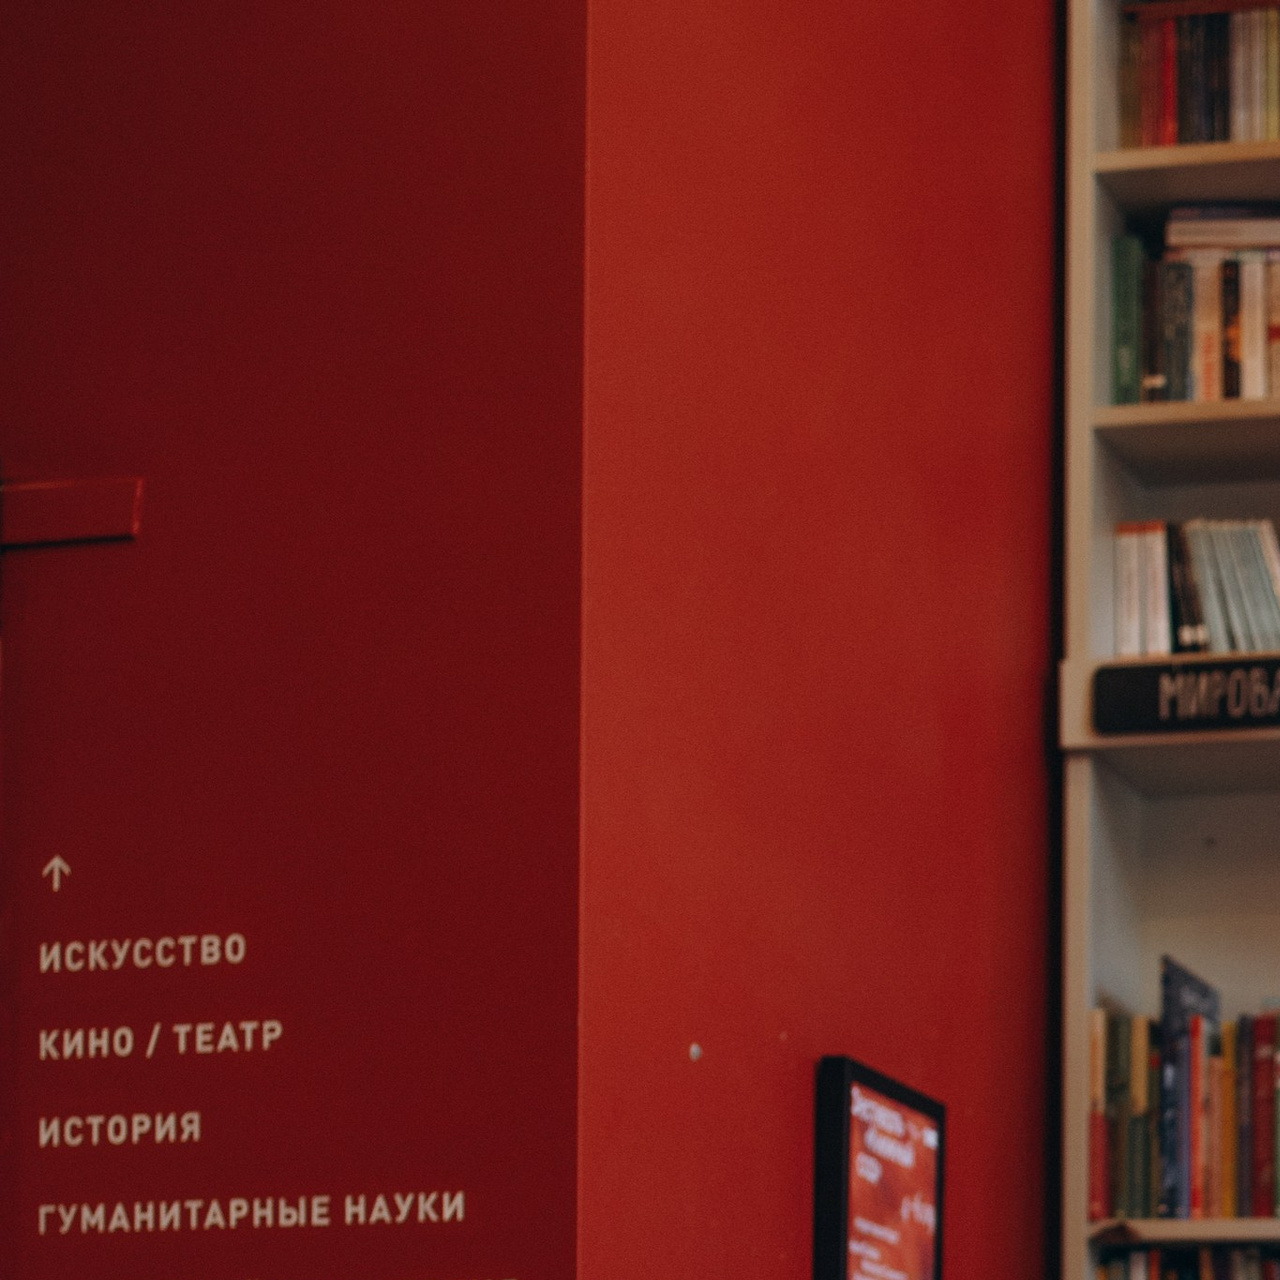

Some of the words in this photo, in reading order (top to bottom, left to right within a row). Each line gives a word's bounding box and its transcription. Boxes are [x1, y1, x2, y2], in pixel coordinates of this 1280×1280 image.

[40, 934, 247, 973] ИСКУССТВО
[40, 1026, 135, 1061] КИНО
[144, 1024, 162, 1059] /
[172, 1021, 284, 1055] ТЕАТР
[40, 1112, 202, 1148] ИСТОРИЯ
[39, 1195, 331, 1235] ГУМАНИТАРНЫЕ
[344, 1191, 467, 1226] НАУКИ
